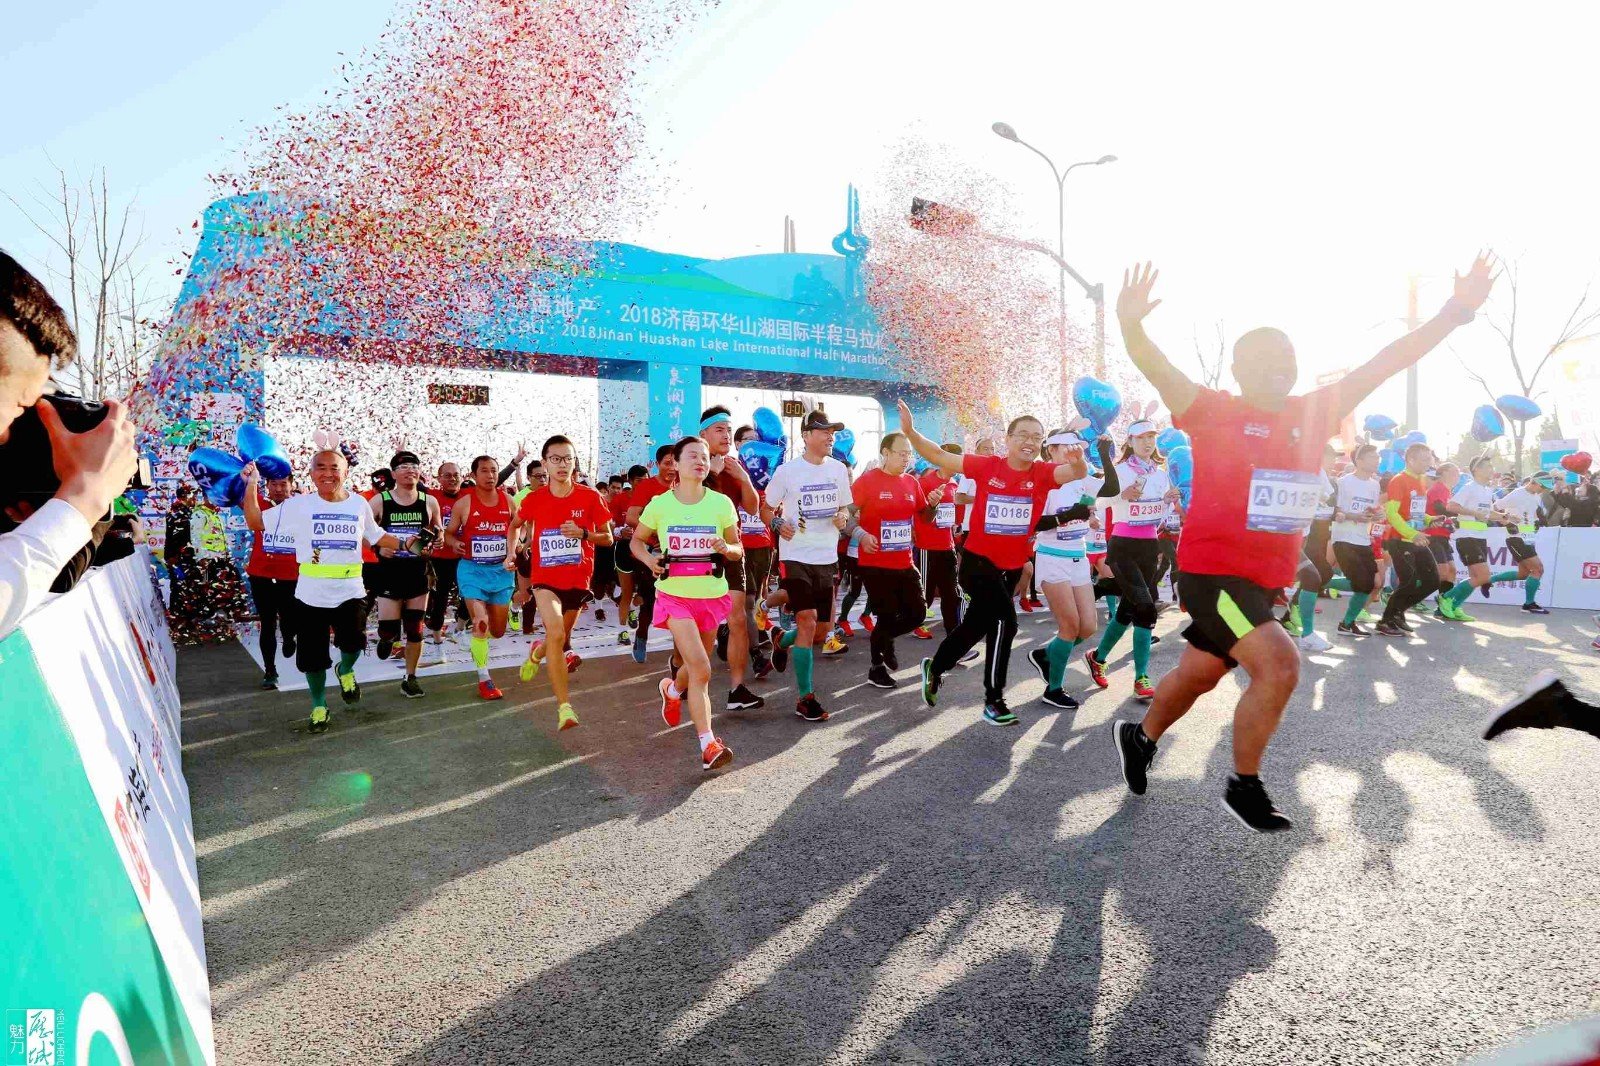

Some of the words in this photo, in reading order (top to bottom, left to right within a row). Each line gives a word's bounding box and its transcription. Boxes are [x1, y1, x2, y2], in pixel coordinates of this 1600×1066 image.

[639, 329, 696, 348] Huashan
[701, 337, 729, 352] Lake
[733, 339, 810, 359] International
[815, 493, 837, 504] 1196
[390, 512, 422, 522] QIAODAN
[1001, 507, 1030, 519] 0186
[327, 524, 357, 535] 0880
[483, 543, 505, 553] 0602
[551, 538, 579, 550] 0862
